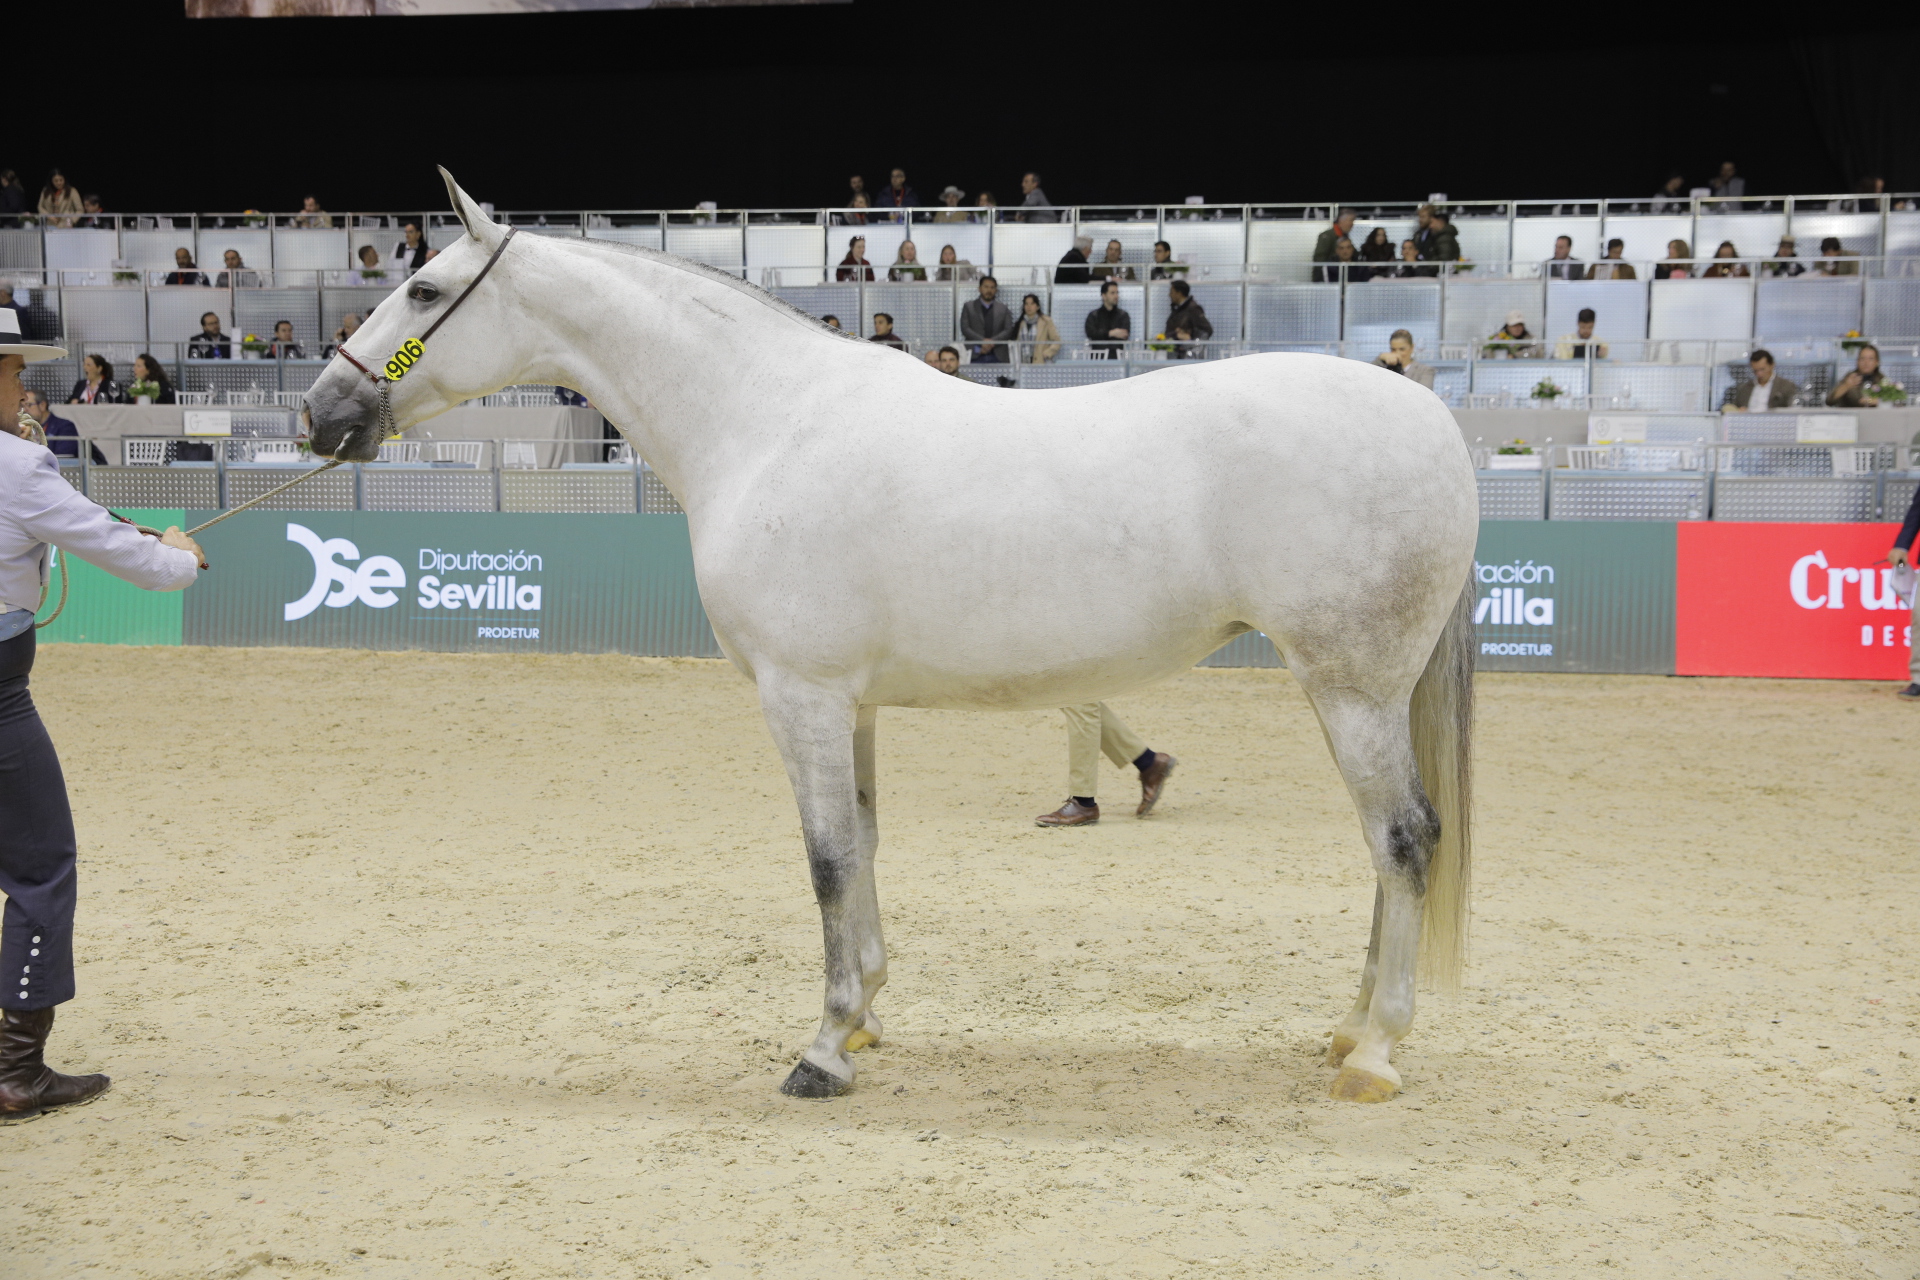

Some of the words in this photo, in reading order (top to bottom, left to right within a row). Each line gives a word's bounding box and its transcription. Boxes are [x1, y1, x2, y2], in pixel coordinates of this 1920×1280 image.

[386, 340, 423, 378] 906
[419, 549, 542, 575] Diputación
[1475, 560, 1554, 584] tación
[417, 575, 542, 610] Sevilla
[1474, 587, 1554, 626] villa
[477, 627, 540, 639] PRODETUR
[1481, 643, 1553, 656] PRODETUR
